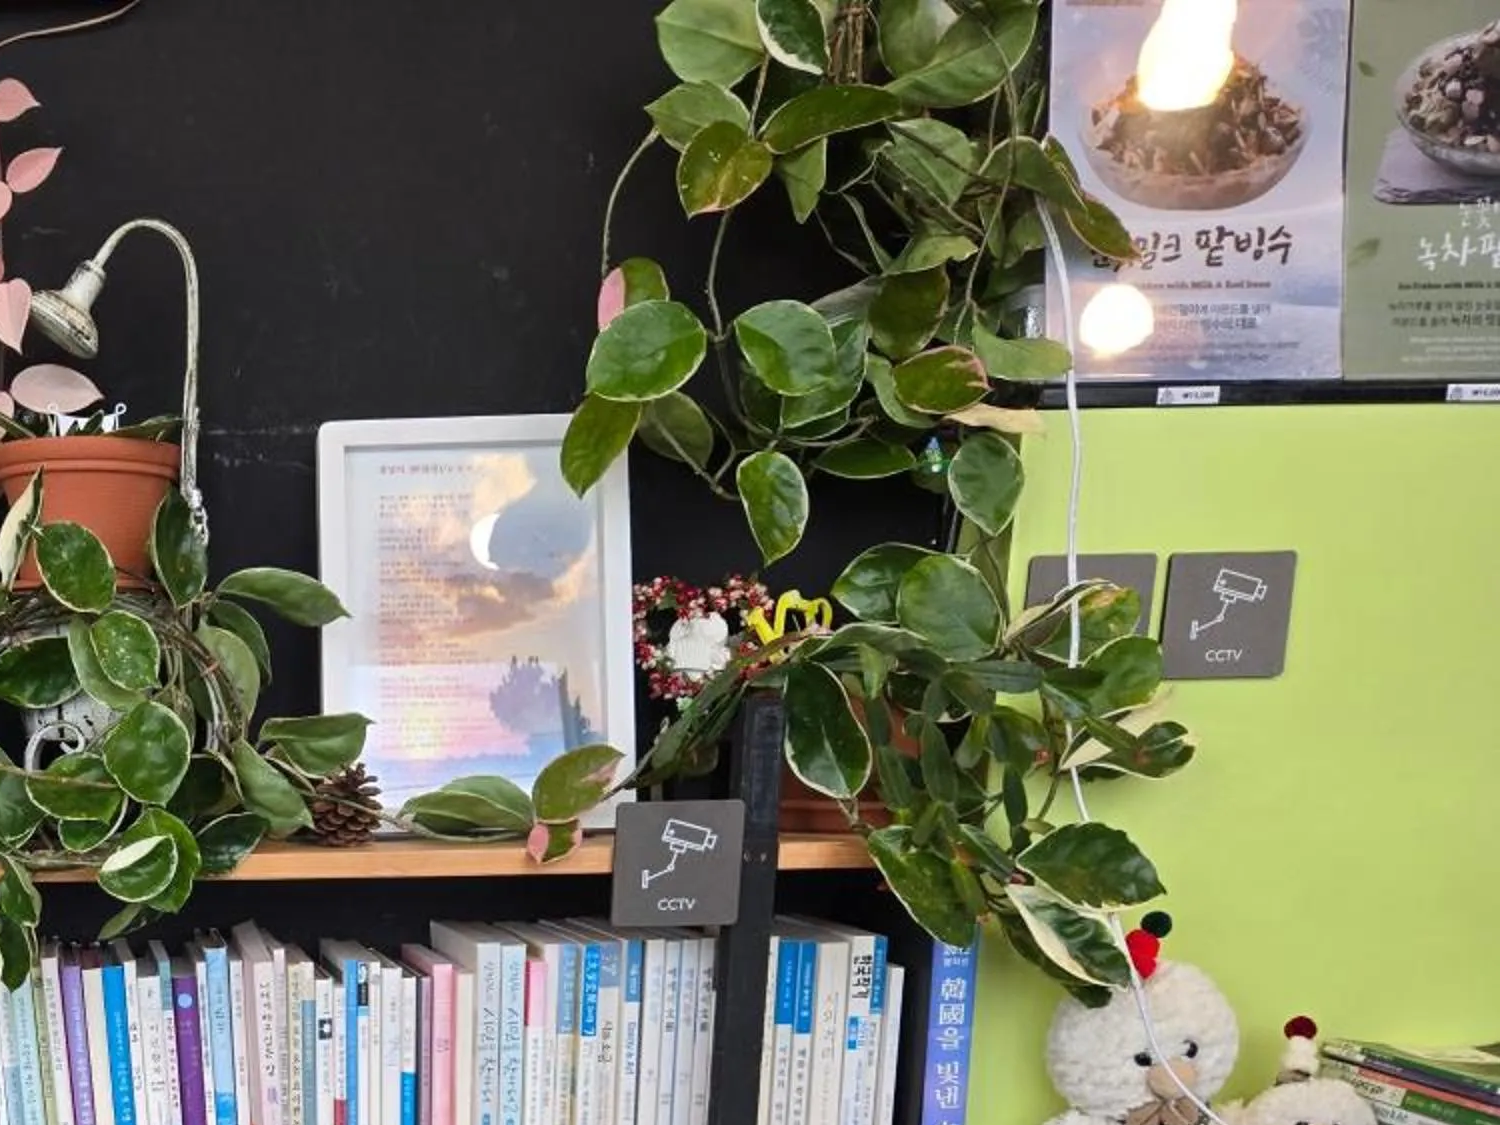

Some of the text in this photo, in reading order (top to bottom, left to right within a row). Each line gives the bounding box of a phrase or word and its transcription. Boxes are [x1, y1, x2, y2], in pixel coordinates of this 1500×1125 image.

[1195, 224, 1293, 268] 팥빙수
[1205, 650, 1243, 662] CCTV
[657, 897, 696, 911] CCTV
[853, 954, 873, 1000] 한국작가
[480, 1007, 497, 1051] 시인을
[505, 1007, 522, 1054] 시인을
[938, 977, 967, 1050] 韓國을
[478, 1056, 495, 1106] 찾아서
[935, 1062, 960, 1110] 빛낸
